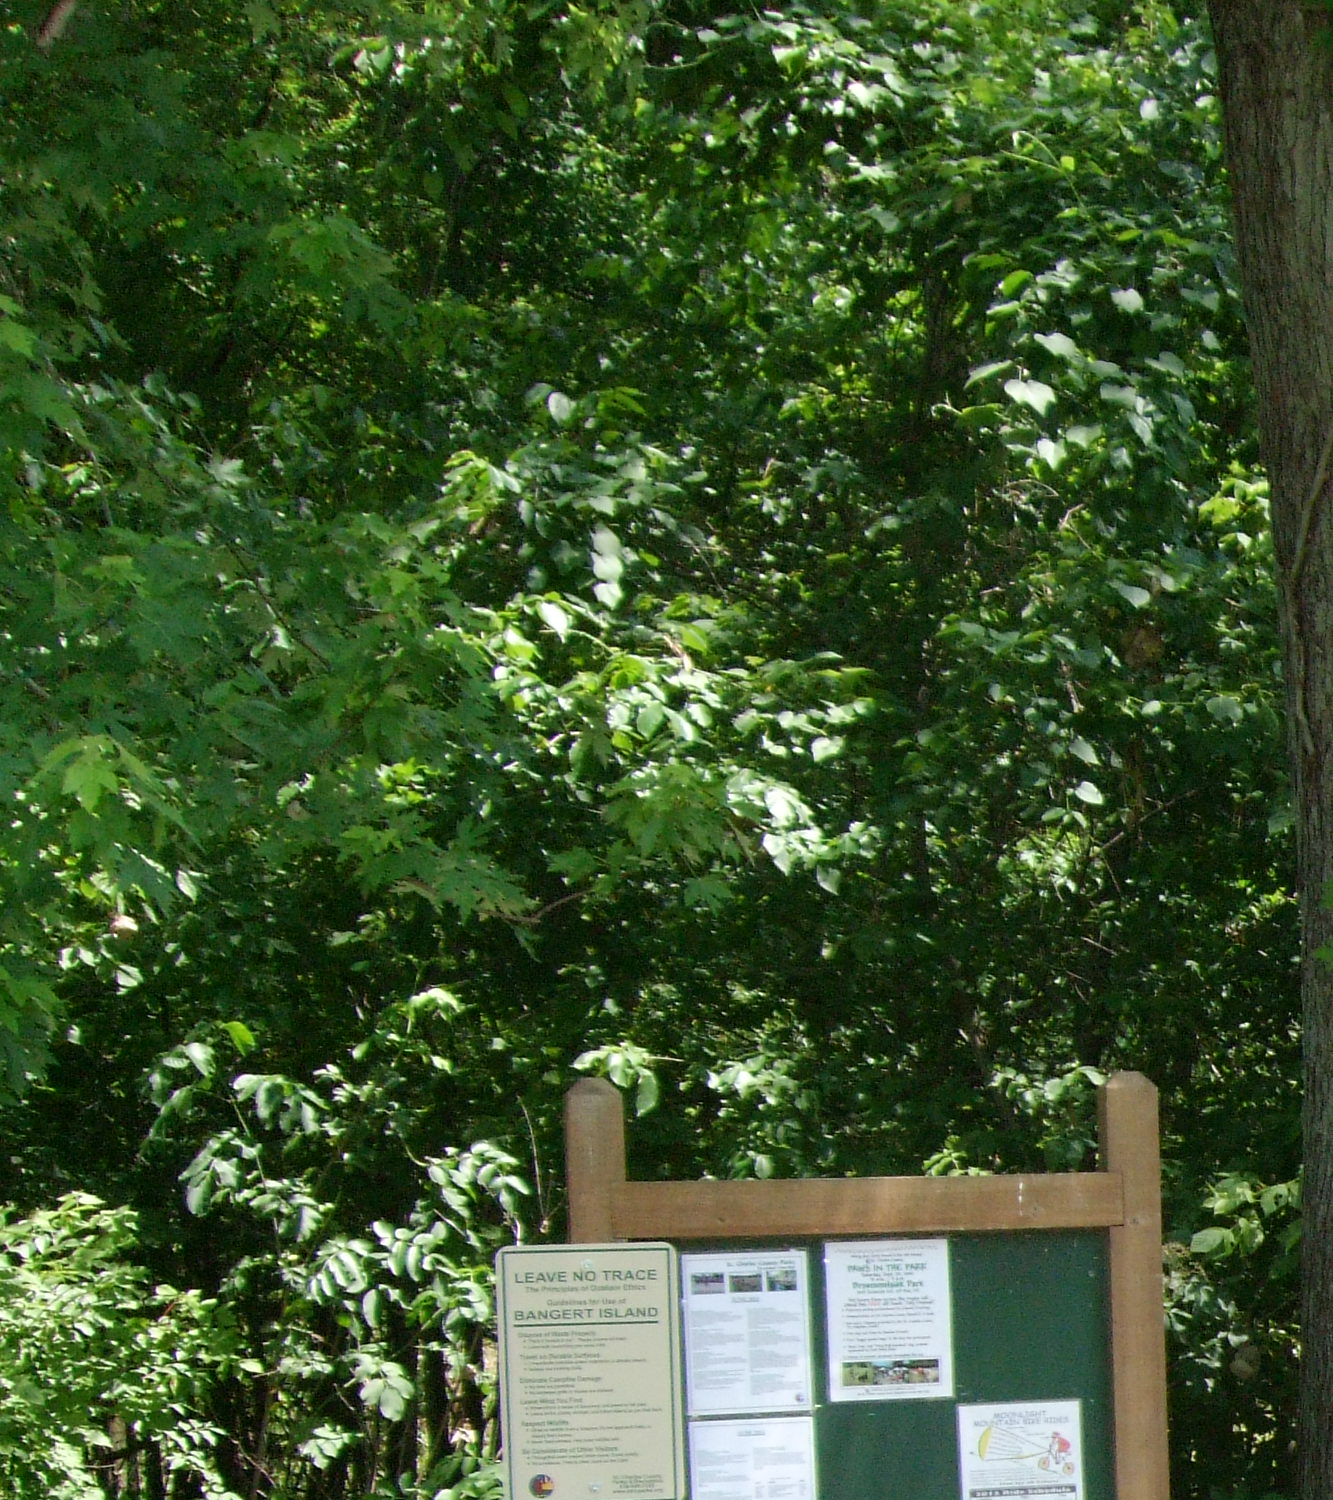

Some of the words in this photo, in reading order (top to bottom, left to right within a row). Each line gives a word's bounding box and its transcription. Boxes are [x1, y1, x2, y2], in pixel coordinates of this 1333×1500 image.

[515, 1271, 566, 1284] LEAVE
[573, 1271, 595, 1282] NO
[603, 1269, 657, 1281] TRACE
[515, 1308, 594, 1321] BANGERT
[600, 1308, 658, 1318] ISLAND
